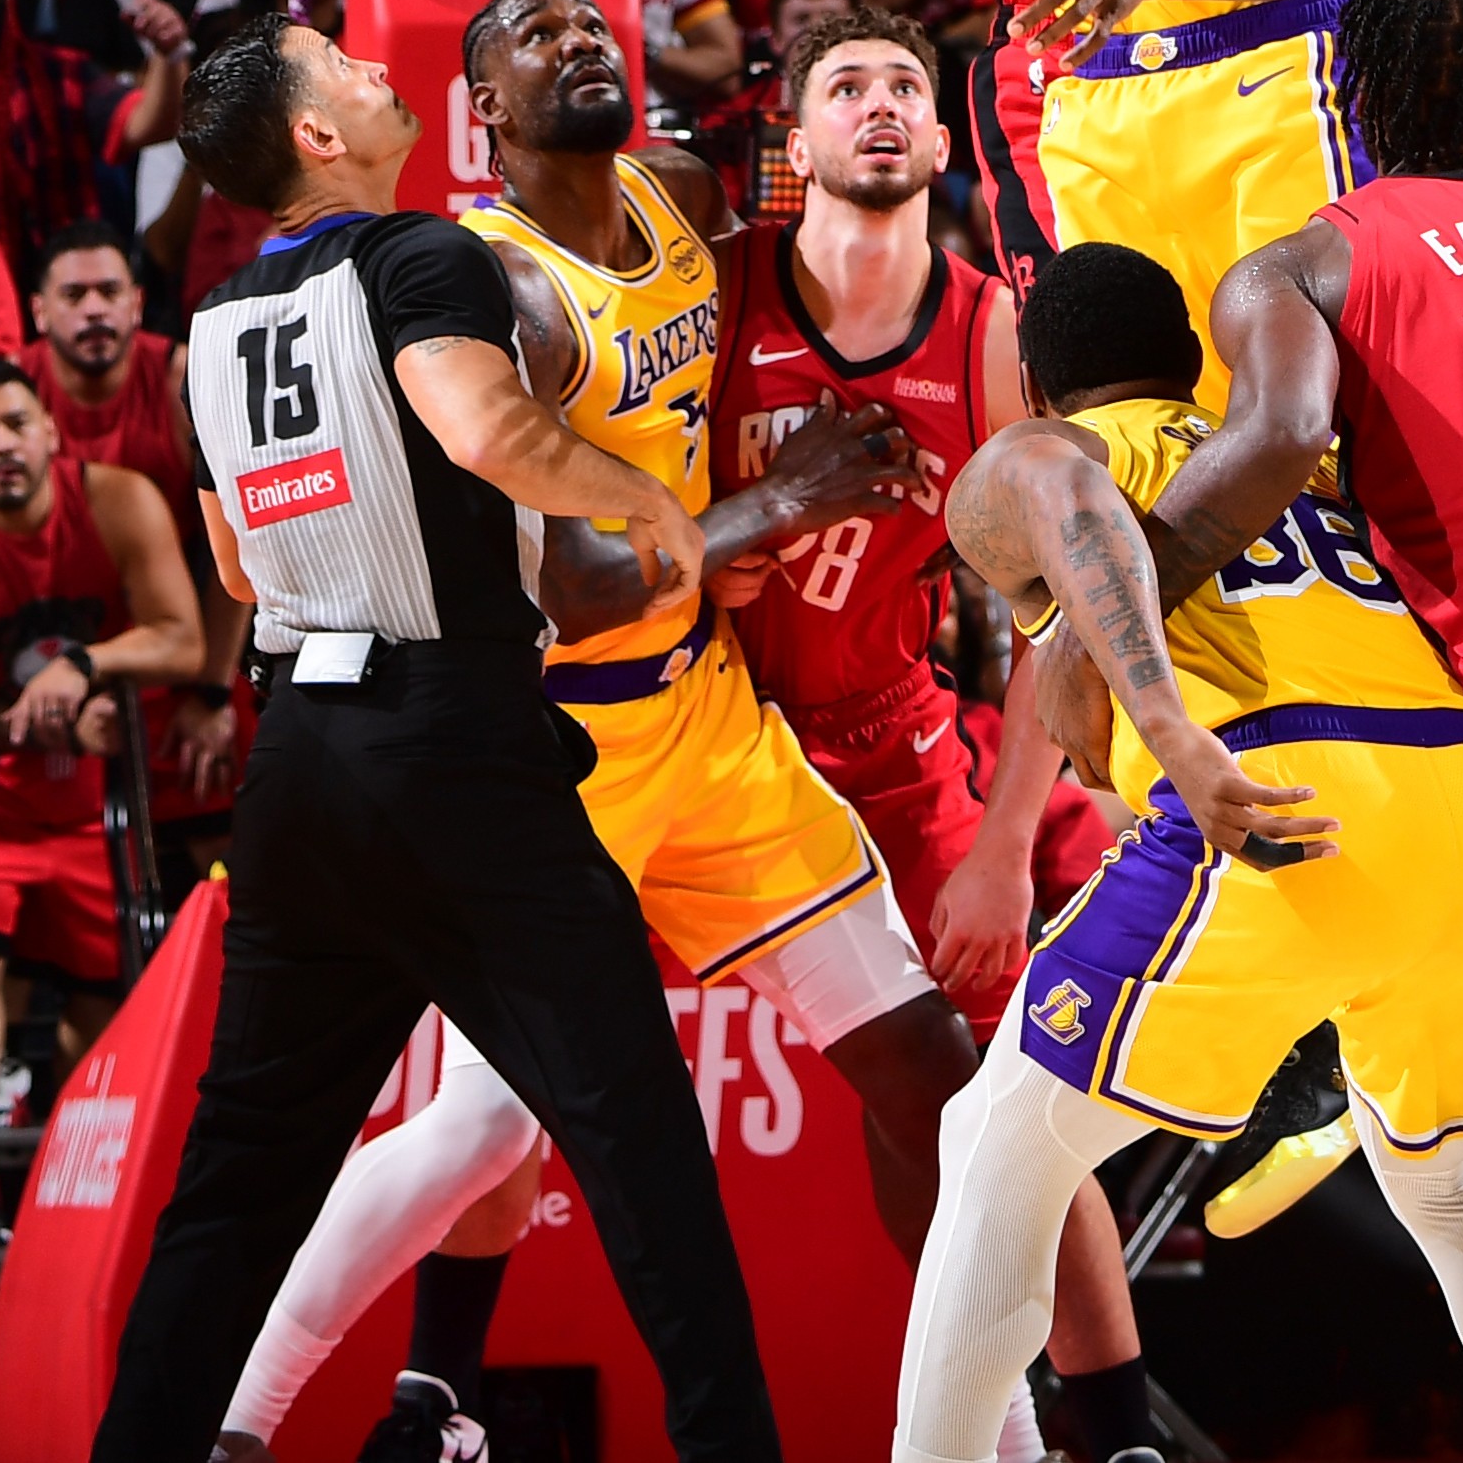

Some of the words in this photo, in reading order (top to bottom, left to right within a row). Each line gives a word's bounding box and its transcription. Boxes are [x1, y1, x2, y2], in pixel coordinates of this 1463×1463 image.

[237, 314, 319, 448] 15
[607, 292, 718, 421] LAKERS
[244, 469, 336, 514] Emirates
[778, 515, 873, 612] 8
[1061, 511, 1165, 689] DALLAS
